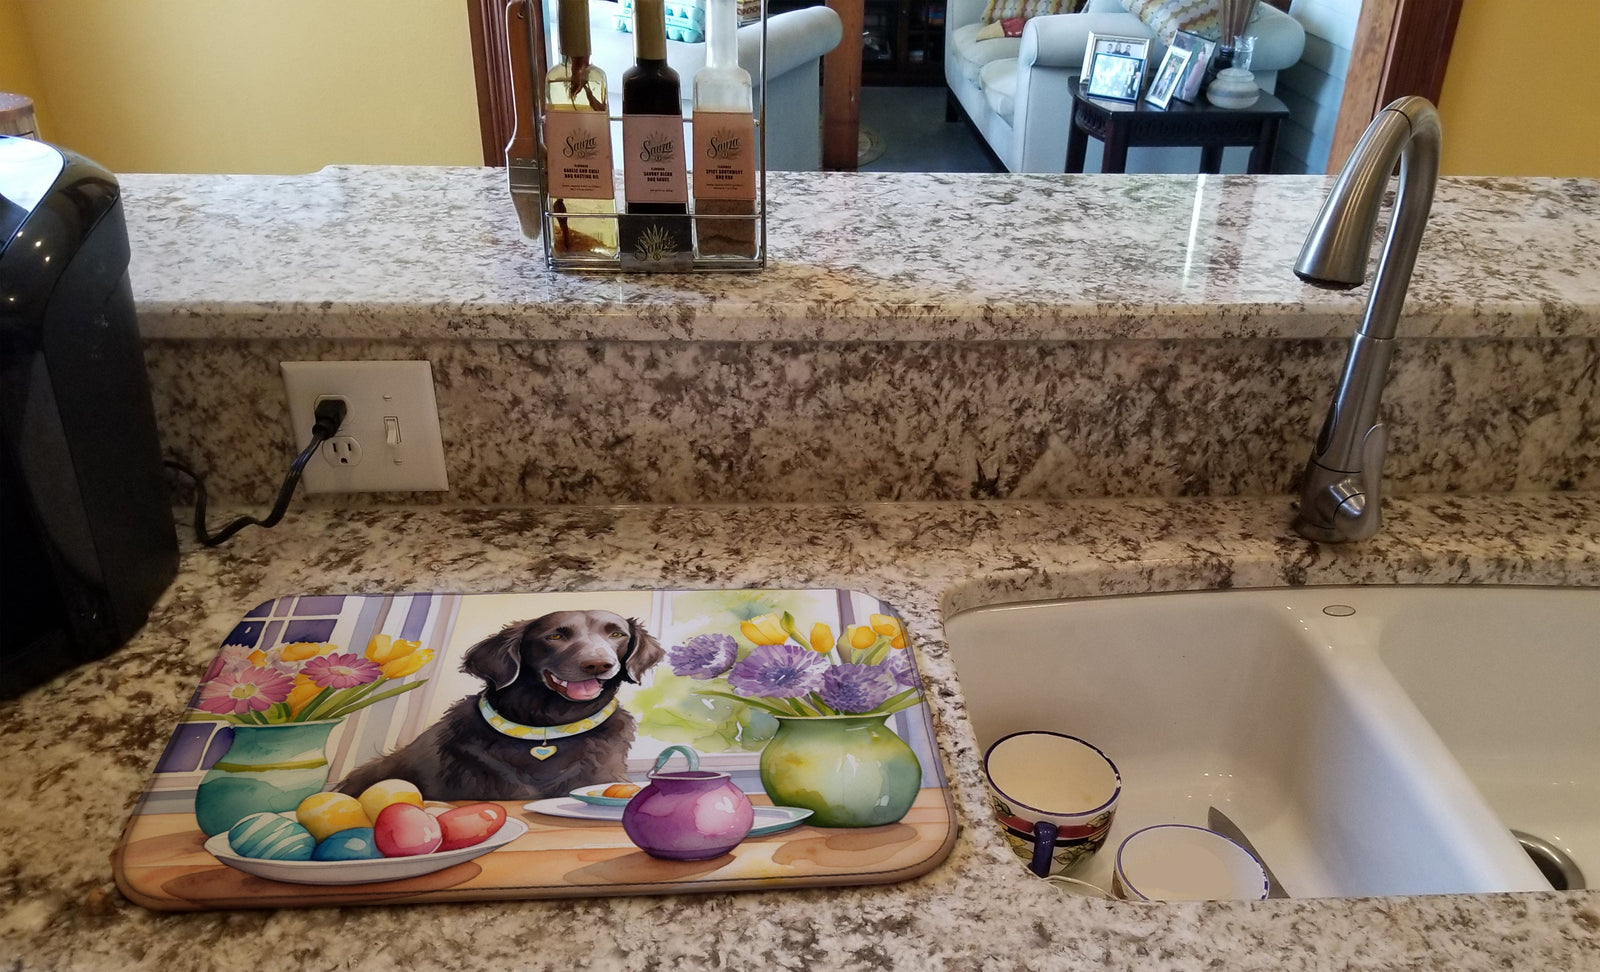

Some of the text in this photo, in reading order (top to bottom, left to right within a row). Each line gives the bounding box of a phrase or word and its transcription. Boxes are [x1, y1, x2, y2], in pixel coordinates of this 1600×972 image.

[563, 136, 597, 158] Sauza
[640, 140, 674, 161] Sauza
[707, 136, 740, 158] Sauza
